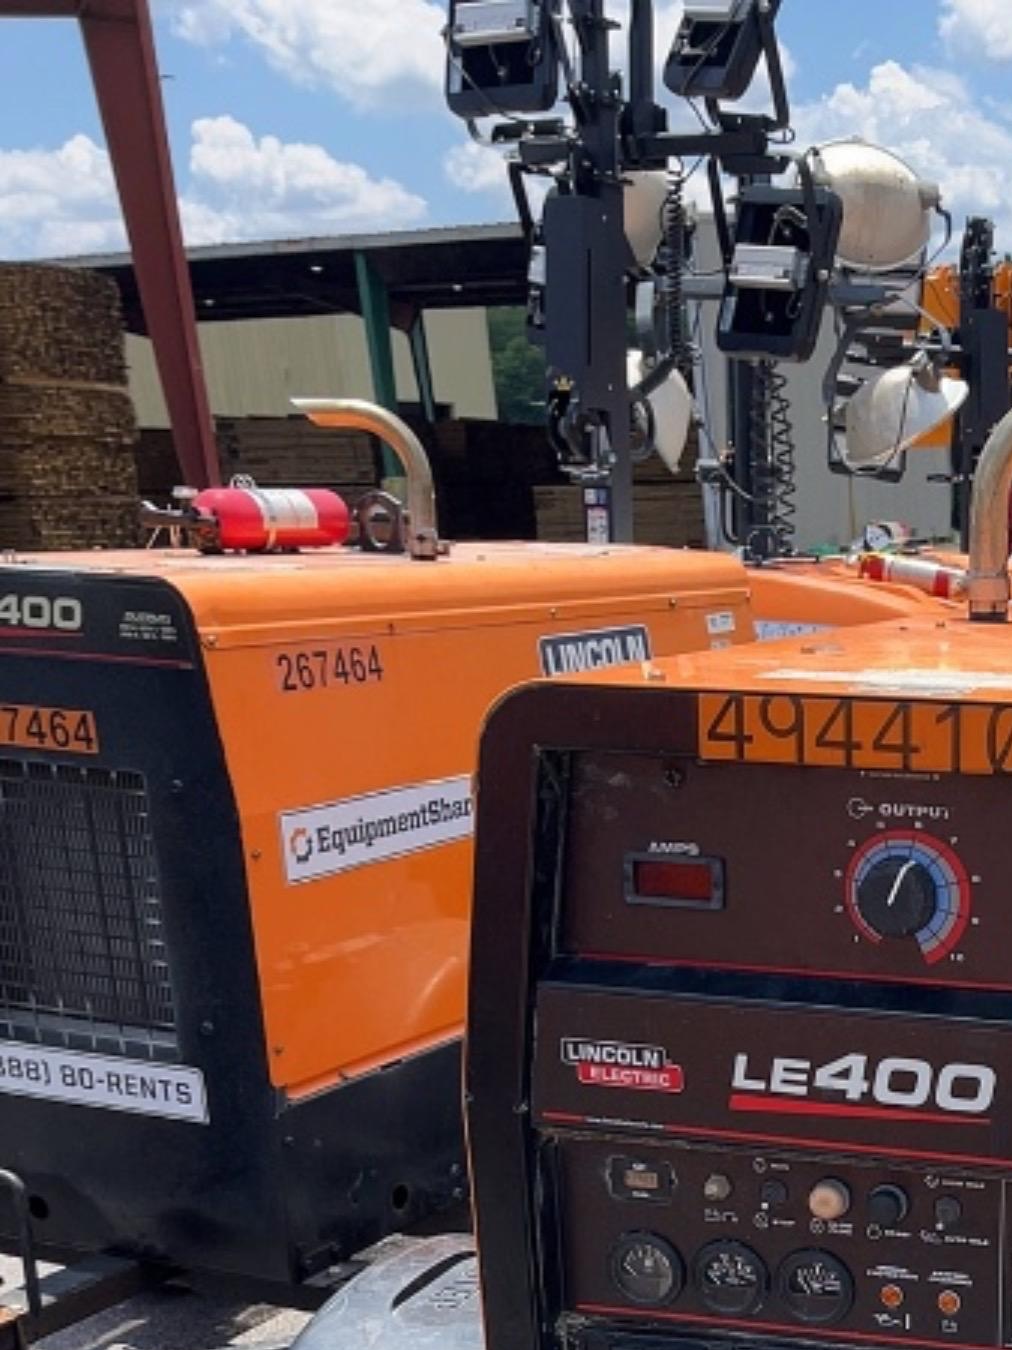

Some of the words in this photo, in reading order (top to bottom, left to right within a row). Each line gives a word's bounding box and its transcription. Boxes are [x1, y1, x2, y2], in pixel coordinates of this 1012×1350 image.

[277, 646, 384, 692] 267464
[545, 634, 645, 676] LINCOLN
[316, 797, 472, 855] EquipmentShar
[879, 803, 950, 820] OUTPUT
[567, 1043, 658, 1069] LINCOLN
[590, 1066, 672, 1088] ELECTRIC
[731, 1053, 997, 1113] LE400
